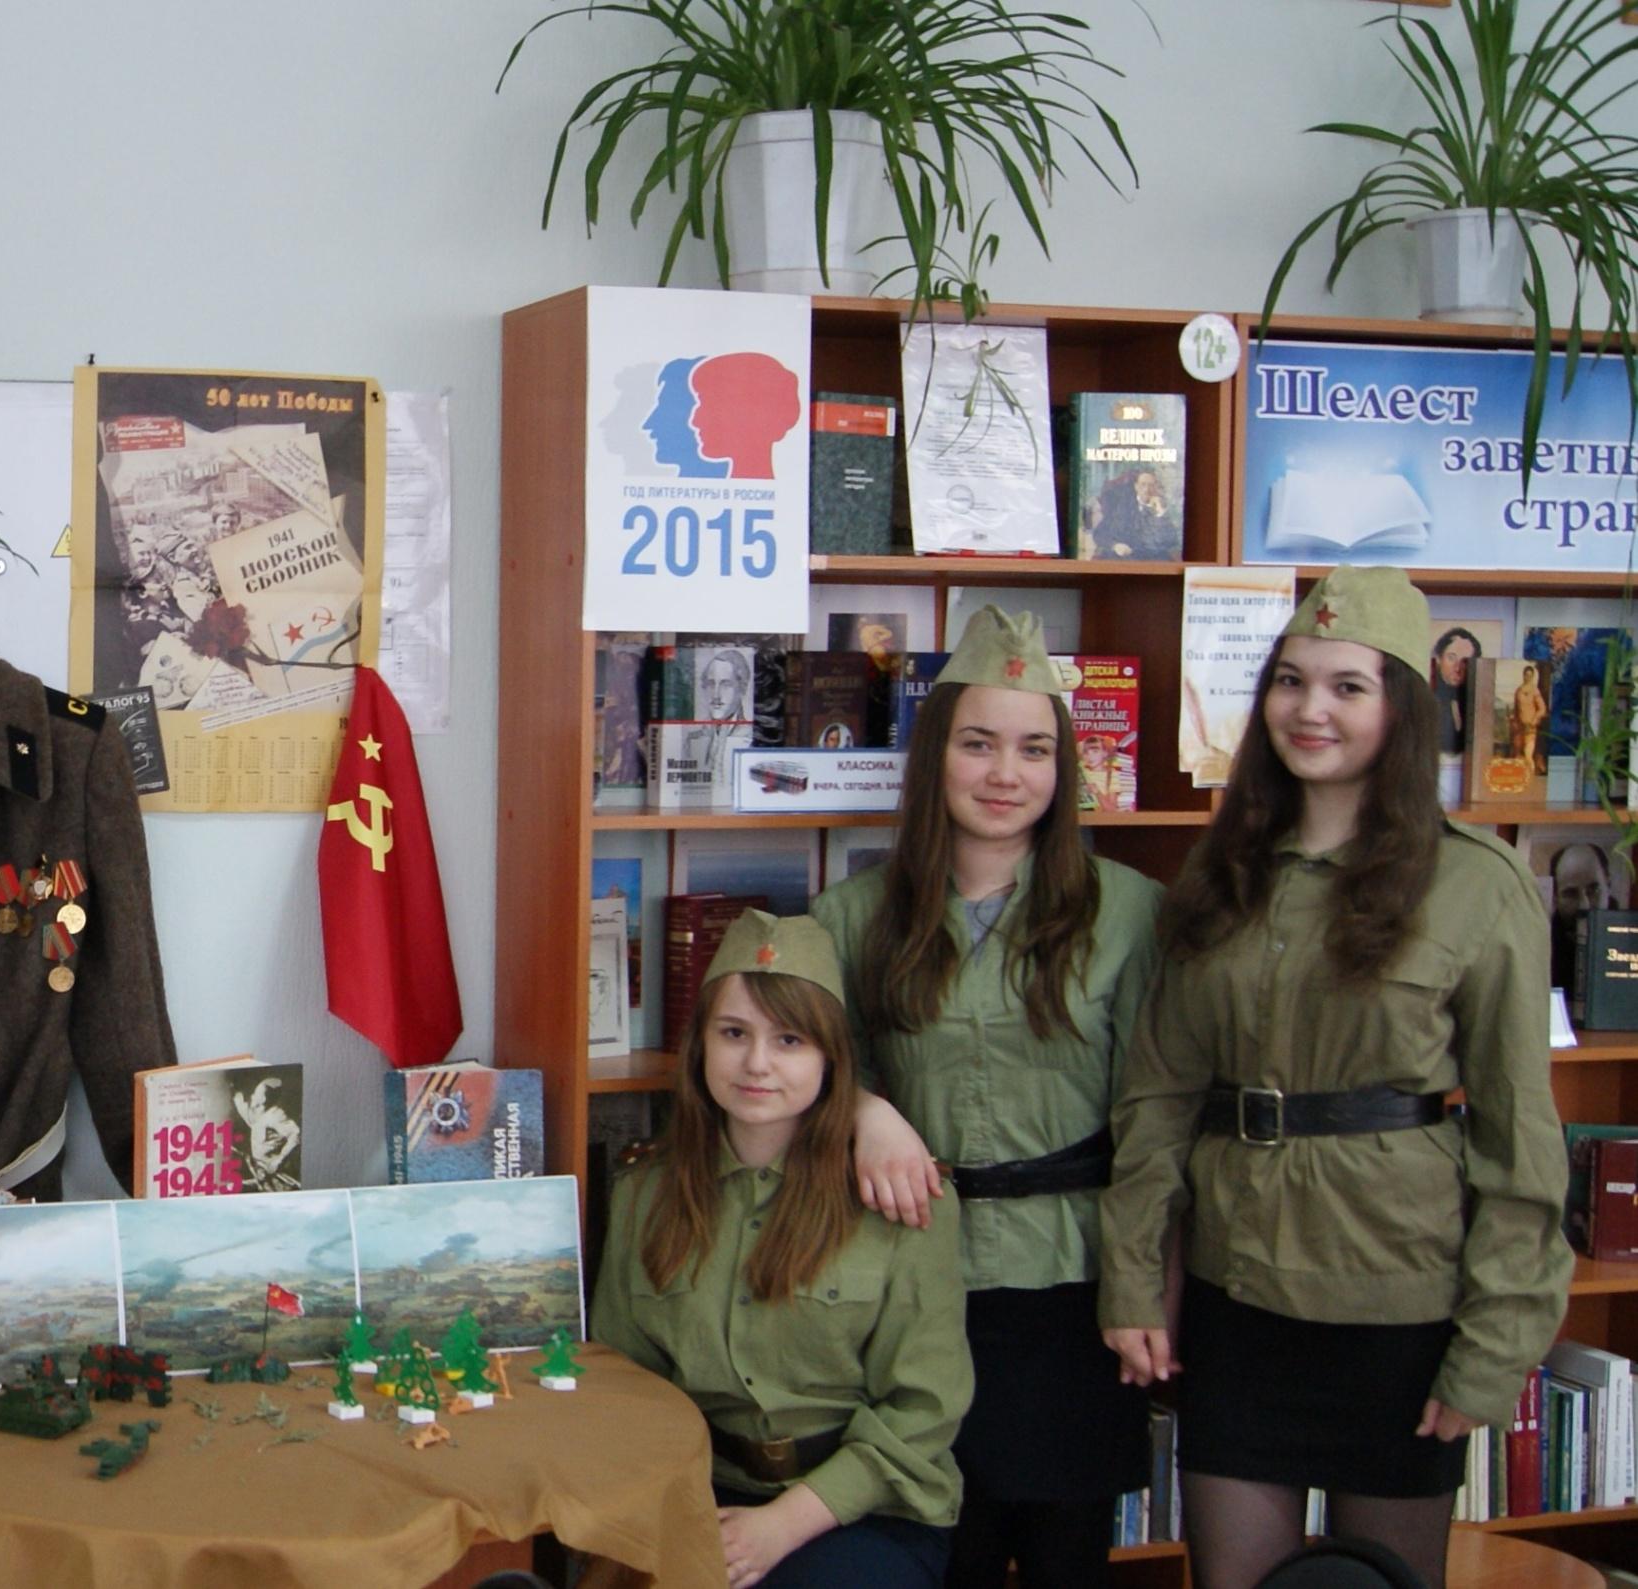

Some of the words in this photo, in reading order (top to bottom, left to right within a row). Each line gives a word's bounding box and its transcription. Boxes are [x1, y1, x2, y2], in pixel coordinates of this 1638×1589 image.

[1193, 328, 1227, 369] 12+
[207, 388, 231, 406] 50
[237, 392, 270, 407] лет
[277, 390, 354, 412] Победы
[1259, 366, 1477, 424] Шелест
[1100, 428, 1164, 446] ВЕЛИКИХ
[623, 485, 645, 499] ГОД
[648, 486, 721, 500] ЛИТЕРАТУРЫ
[723, 489, 730, 500] В
[733, 489, 776, 501] РОССИИ
[268, 528, 295, 548] 1941
[622, 505, 777, 579] 2015
[245, 550, 342, 594] СБОРНИК
[153, 1158, 243, 1198] 1945
